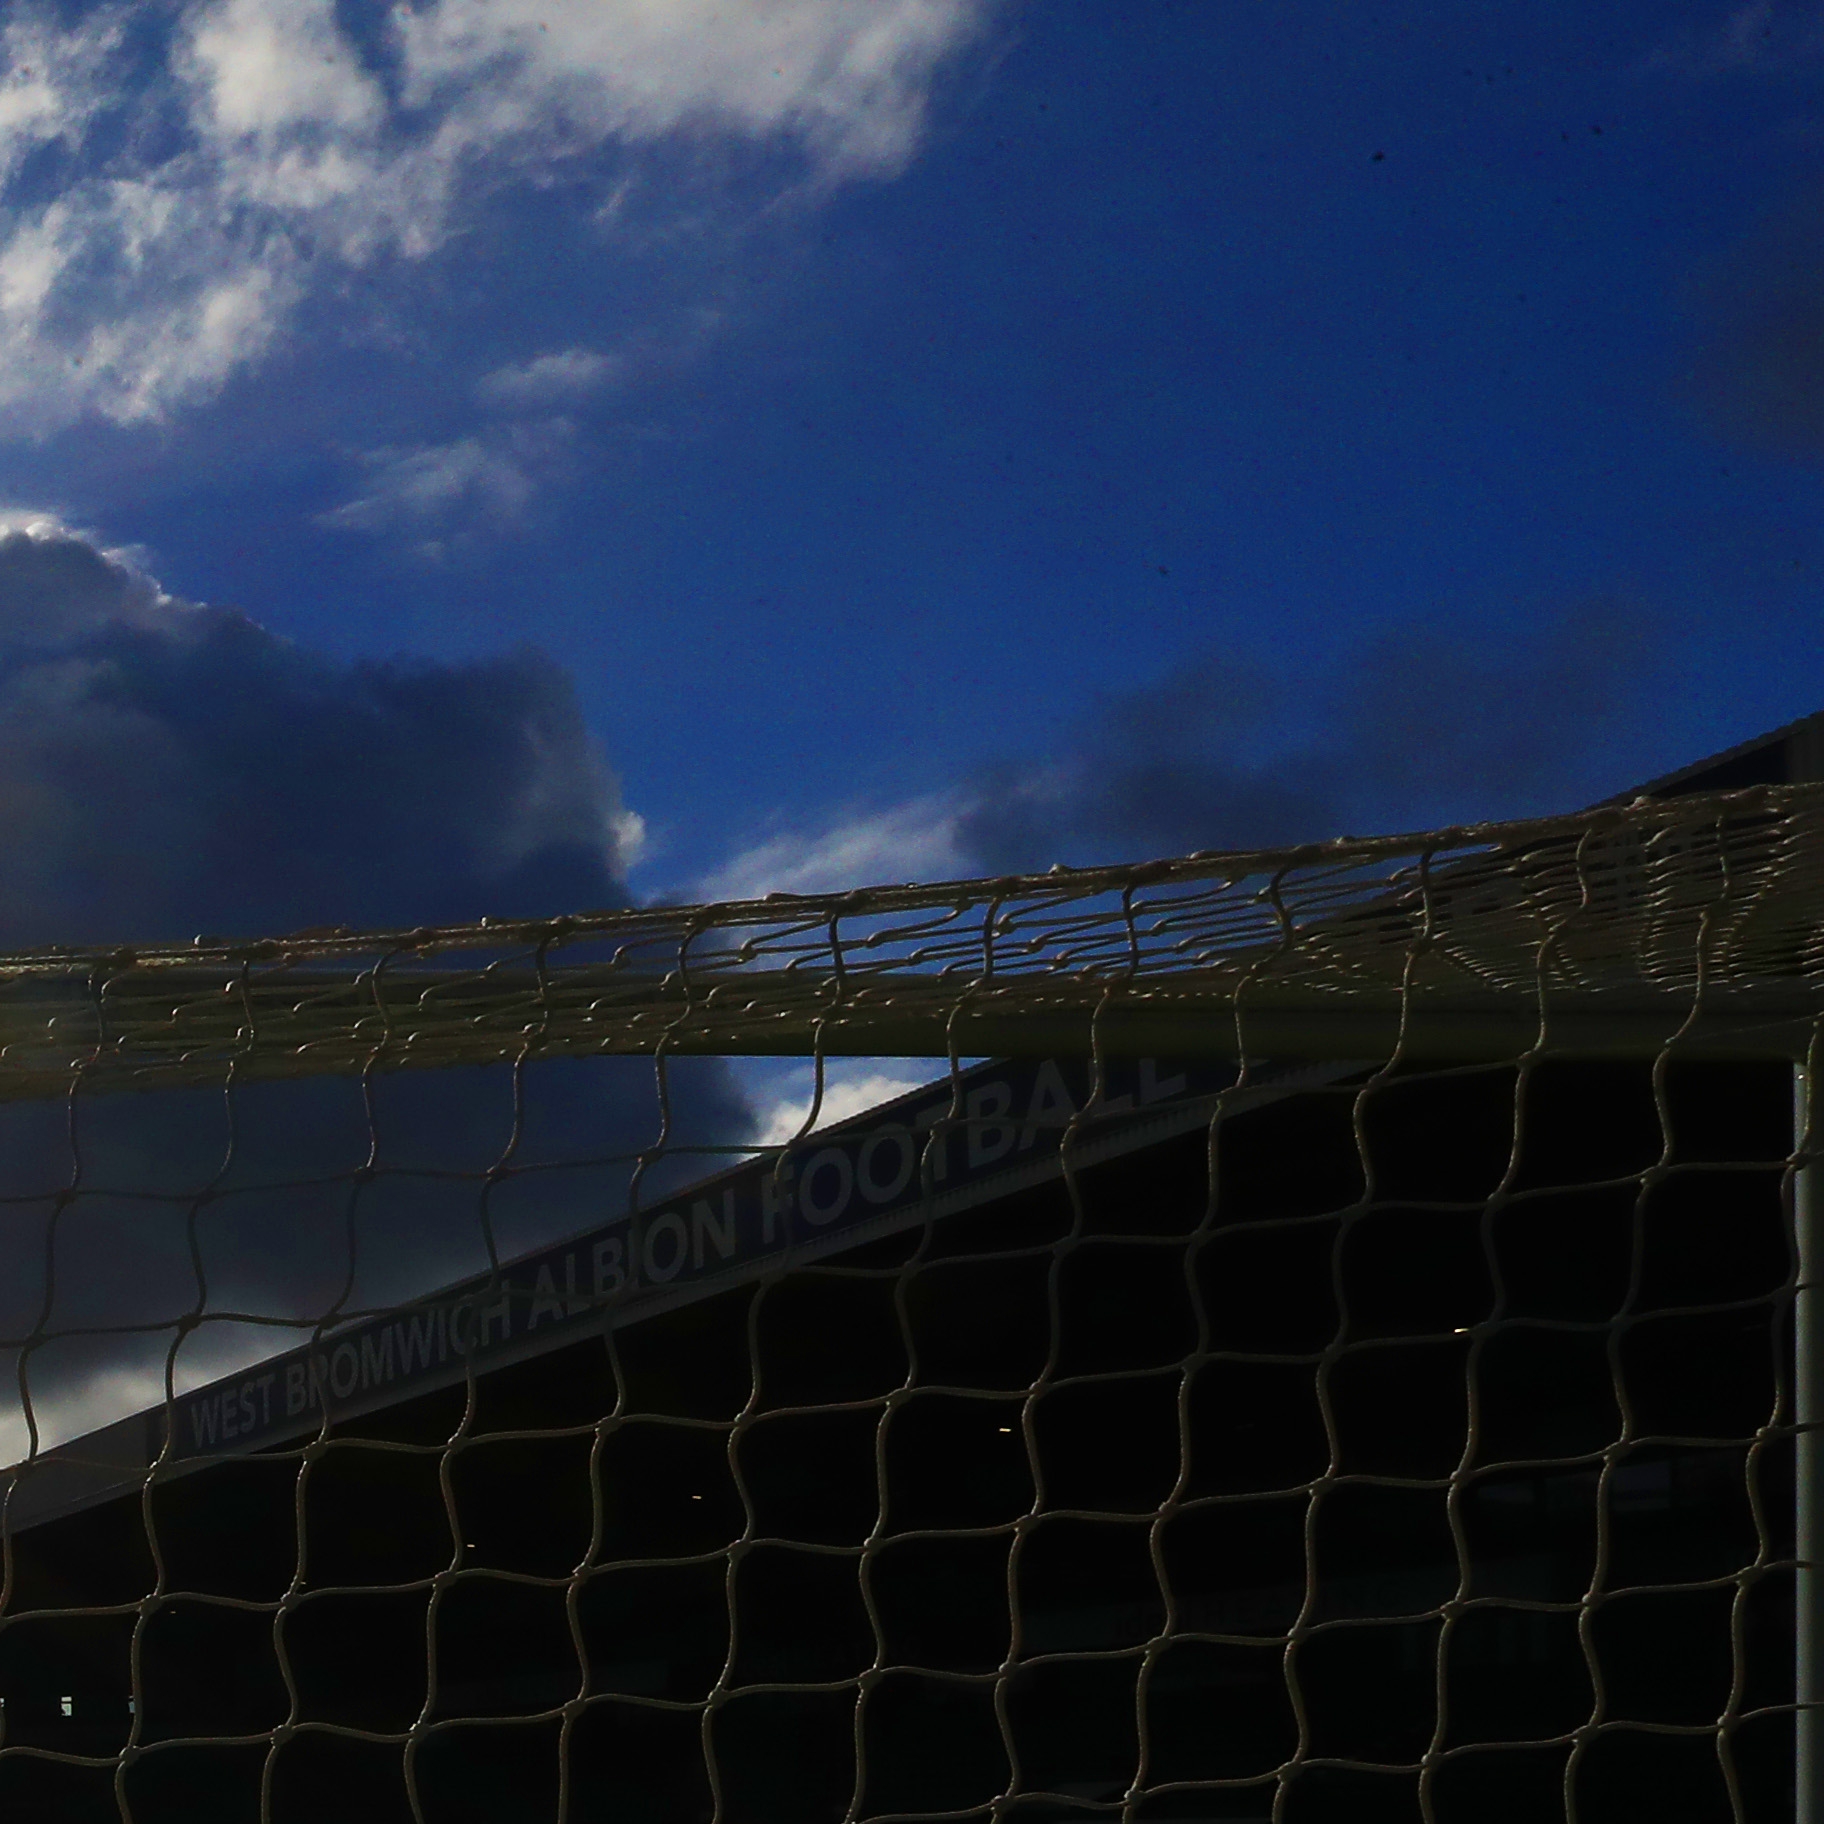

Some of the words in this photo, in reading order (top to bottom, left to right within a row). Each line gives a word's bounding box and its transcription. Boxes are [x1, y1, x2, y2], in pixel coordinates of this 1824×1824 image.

[190, 1373, 276, 1449] WEST
[286, 1280, 512, 1416] BROMWICH
[527, 1188, 736, 1331] ALBION
[760, 1058, 1187, 1245] FOOTBALL
[1115, 1596, 1192, 1639] idel
[1203, 1578, 1402, 1627] HEAING
